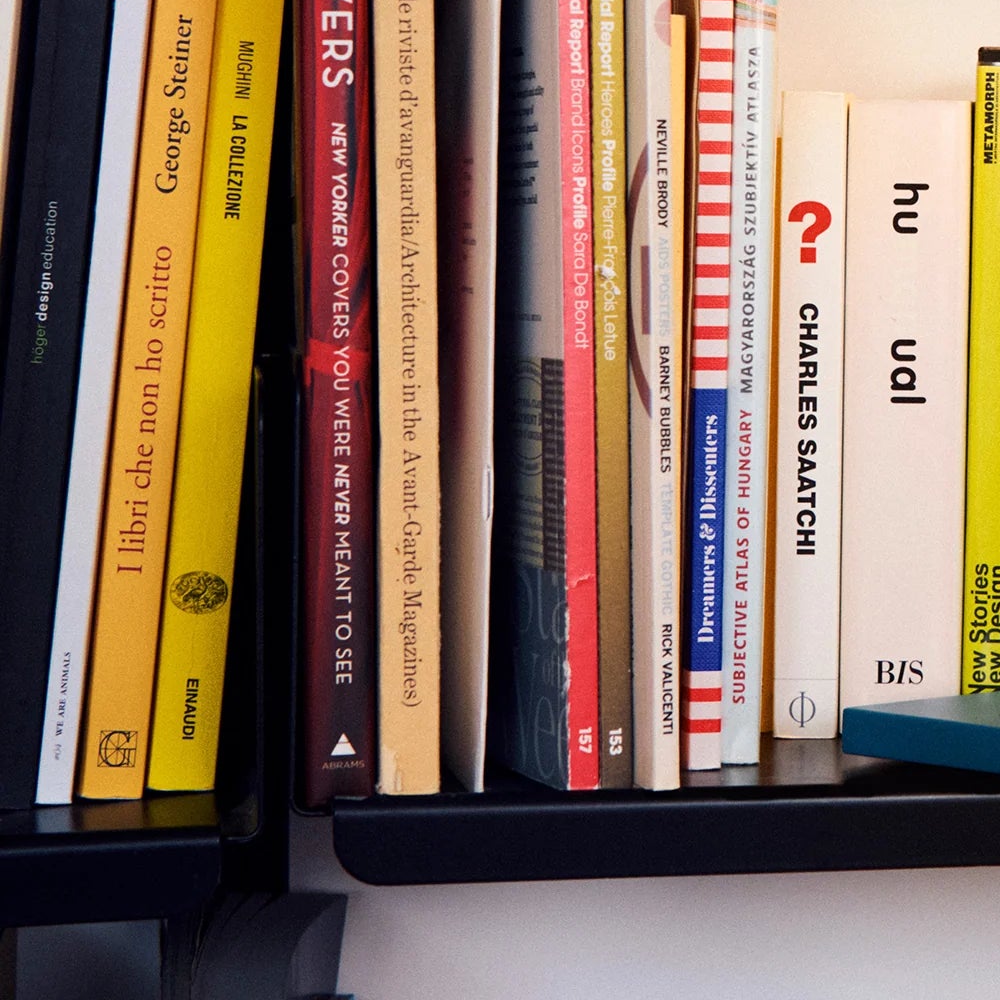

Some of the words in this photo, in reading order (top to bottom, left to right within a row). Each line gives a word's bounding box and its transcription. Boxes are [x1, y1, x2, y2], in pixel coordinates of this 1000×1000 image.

[163, 14, 193, 100] Steiner
[234, 40, 254, 100] MUGHINI
[398, 17, 418, 85] riviste
[567, 18, 586, 75] Report
[597, 20, 616, 78] Report
[570, 77, 585, 126] Brand
[600, 80, 616, 142] Heroes
[746, 46, 761, 122] ATLASZA
[232, 115, 248, 131] LA
[331, 122, 348, 167] NEW
[983, 71, 996, 165] METAMORPH
[155, 107, 191, 194] George
[571, 127, 585, 174] Icons
[601, 141, 617, 193] Profile
[656, 119, 669, 176] NEVILLE
[224, 135, 247, 220] COLLEZIONE
[572, 176, 588, 230] Profile
[657, 180, 670, 228] BRODY
[741, 130, 762, 236] SZUBJEKTÍV
[43, 200, 58, 270] education
[331, 173, 348, 248] YORKER
[787, 200, 832, 264] ?
[892, 182, 930, 234] hu
[573, 232, 589, 270] Sara
[34, 272, 54, 322] design
[145, 245, 173, 329] scritto
[331, 254, 350, 339] COVERS
[574, 272, 589, 297] De
[574, 300, 590, 349] Bondt
[738, 244, 757, 394] MAGYARORSZÁG
[135, 338, 163, 373] ho
[333, 345, 350, 391] YOU
[658, 345, 671, 402] BARNEY
[798, 302, 819, 431] CHARLES
[890, 339, 927, 404] ual
[138, 383, 159, 434] non
[402, 384, 421, 403] in
[333, 398, 351, 457] WERE
[402, 405, 422, 443] the
[660, 407, 672, 474] BUBBLES
[125, 443, 154, 489] che
[699, 414, 719, 520] Dissenters
[738, 408, 754, 499] HUNGARY
[333, 463, 351, 526] NEVER
[402, 448, 422, 586] Avant-Garde
[737, 506, 750, 529] OF
[796, 440, 818, 556] SAATCHI
[119, 499, 148, 555] libri
[699, 522, 717, 541] &
[117, 563, 142, 574] I
[334, 531, 352, 604] MEANT
[697, 543, 717, 643] Dreamers
[734, 537, 750, 592] ATLAS
[335, 613, 352, 641] TO
[969, 563, 989, 644] Stories
[335, 647, 353, 685] SEE
[398, 590, 423, 708] Magazines)
[661, 624, 673, 658] RICK
[732, 600, 748, 704] SUBJECTIVE
[60, 651, 71, 690] ANIMALS
[662, 660, 674, 736] VALICENTI
[875, 659, 925, 685] BIS
[55, 715, 65, 737] WE
[58, 692, 67, 714] ARE
[182, 678, 200, 741] EINAUDI
[321, 760, 366, 770] ABRAMS
[578, 726, 593, 754] 157
[608, 728, 622, 756] 153
